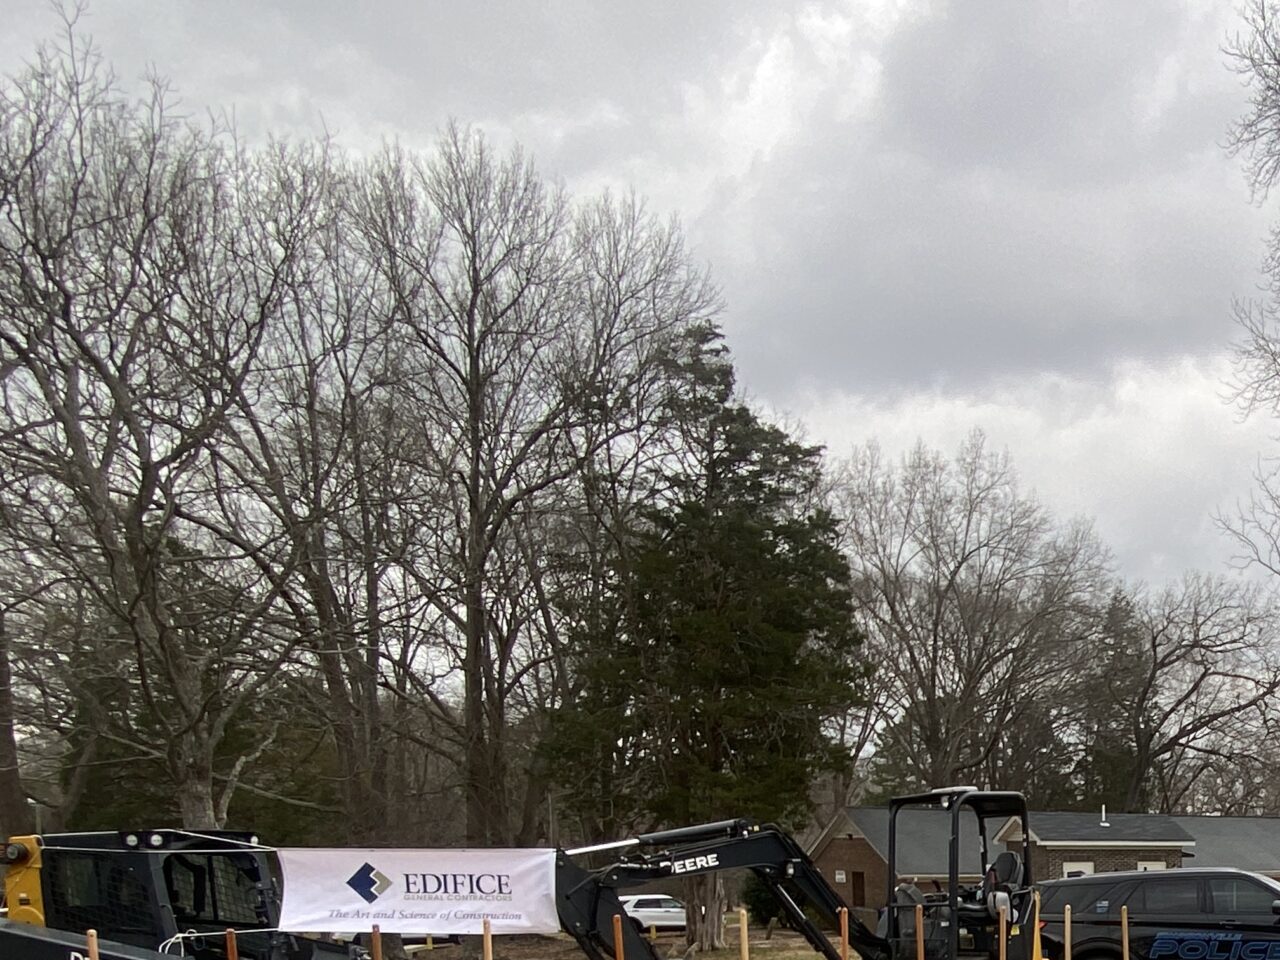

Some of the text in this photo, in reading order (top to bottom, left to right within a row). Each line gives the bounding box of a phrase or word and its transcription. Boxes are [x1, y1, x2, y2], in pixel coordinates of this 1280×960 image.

[659, 853, 720, 874] DEERE
[403, 873, 513, 895] EDIFICE
[447, 894, 513, 902] CONTRACTORS
[328, 909, 522, 921] The Art and Science of Construction
[1154, 931, 1243, 941] SONVILLE
